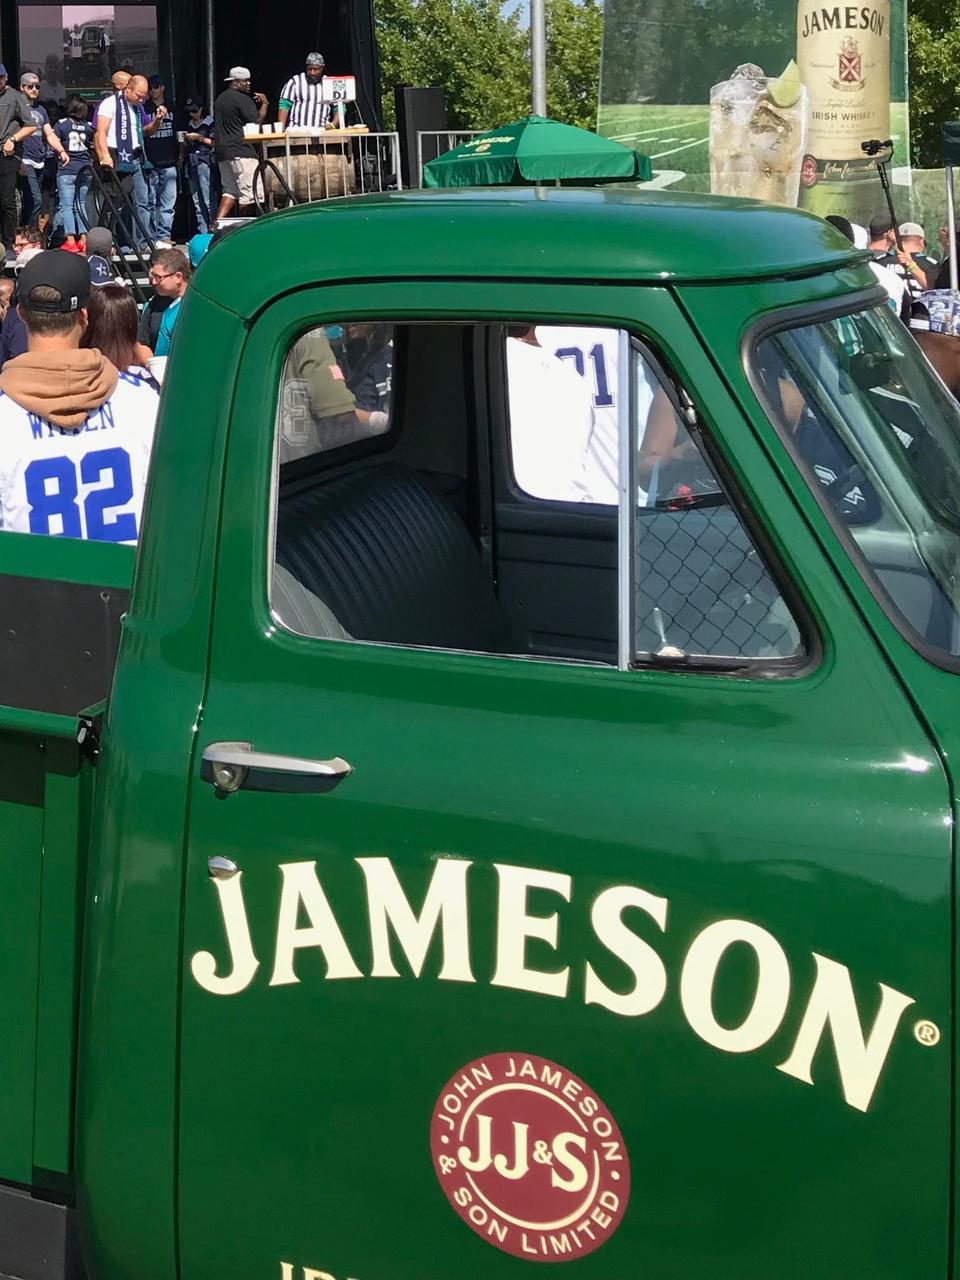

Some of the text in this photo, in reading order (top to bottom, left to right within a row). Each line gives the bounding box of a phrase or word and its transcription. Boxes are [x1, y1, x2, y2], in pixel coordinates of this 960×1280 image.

[802, 6, 884, 37] JAMESON
[333, 91, 347, 100] DJ
[812, 111, 837, 121] IRISH
[24, 447, 137, 541] 82
[438, 1058, 623, 1161] JOHN JAMESON
[458, 1113, 588, 1192] JJ&S
[438, 1155, 620, 1254] & SON LIMITED
